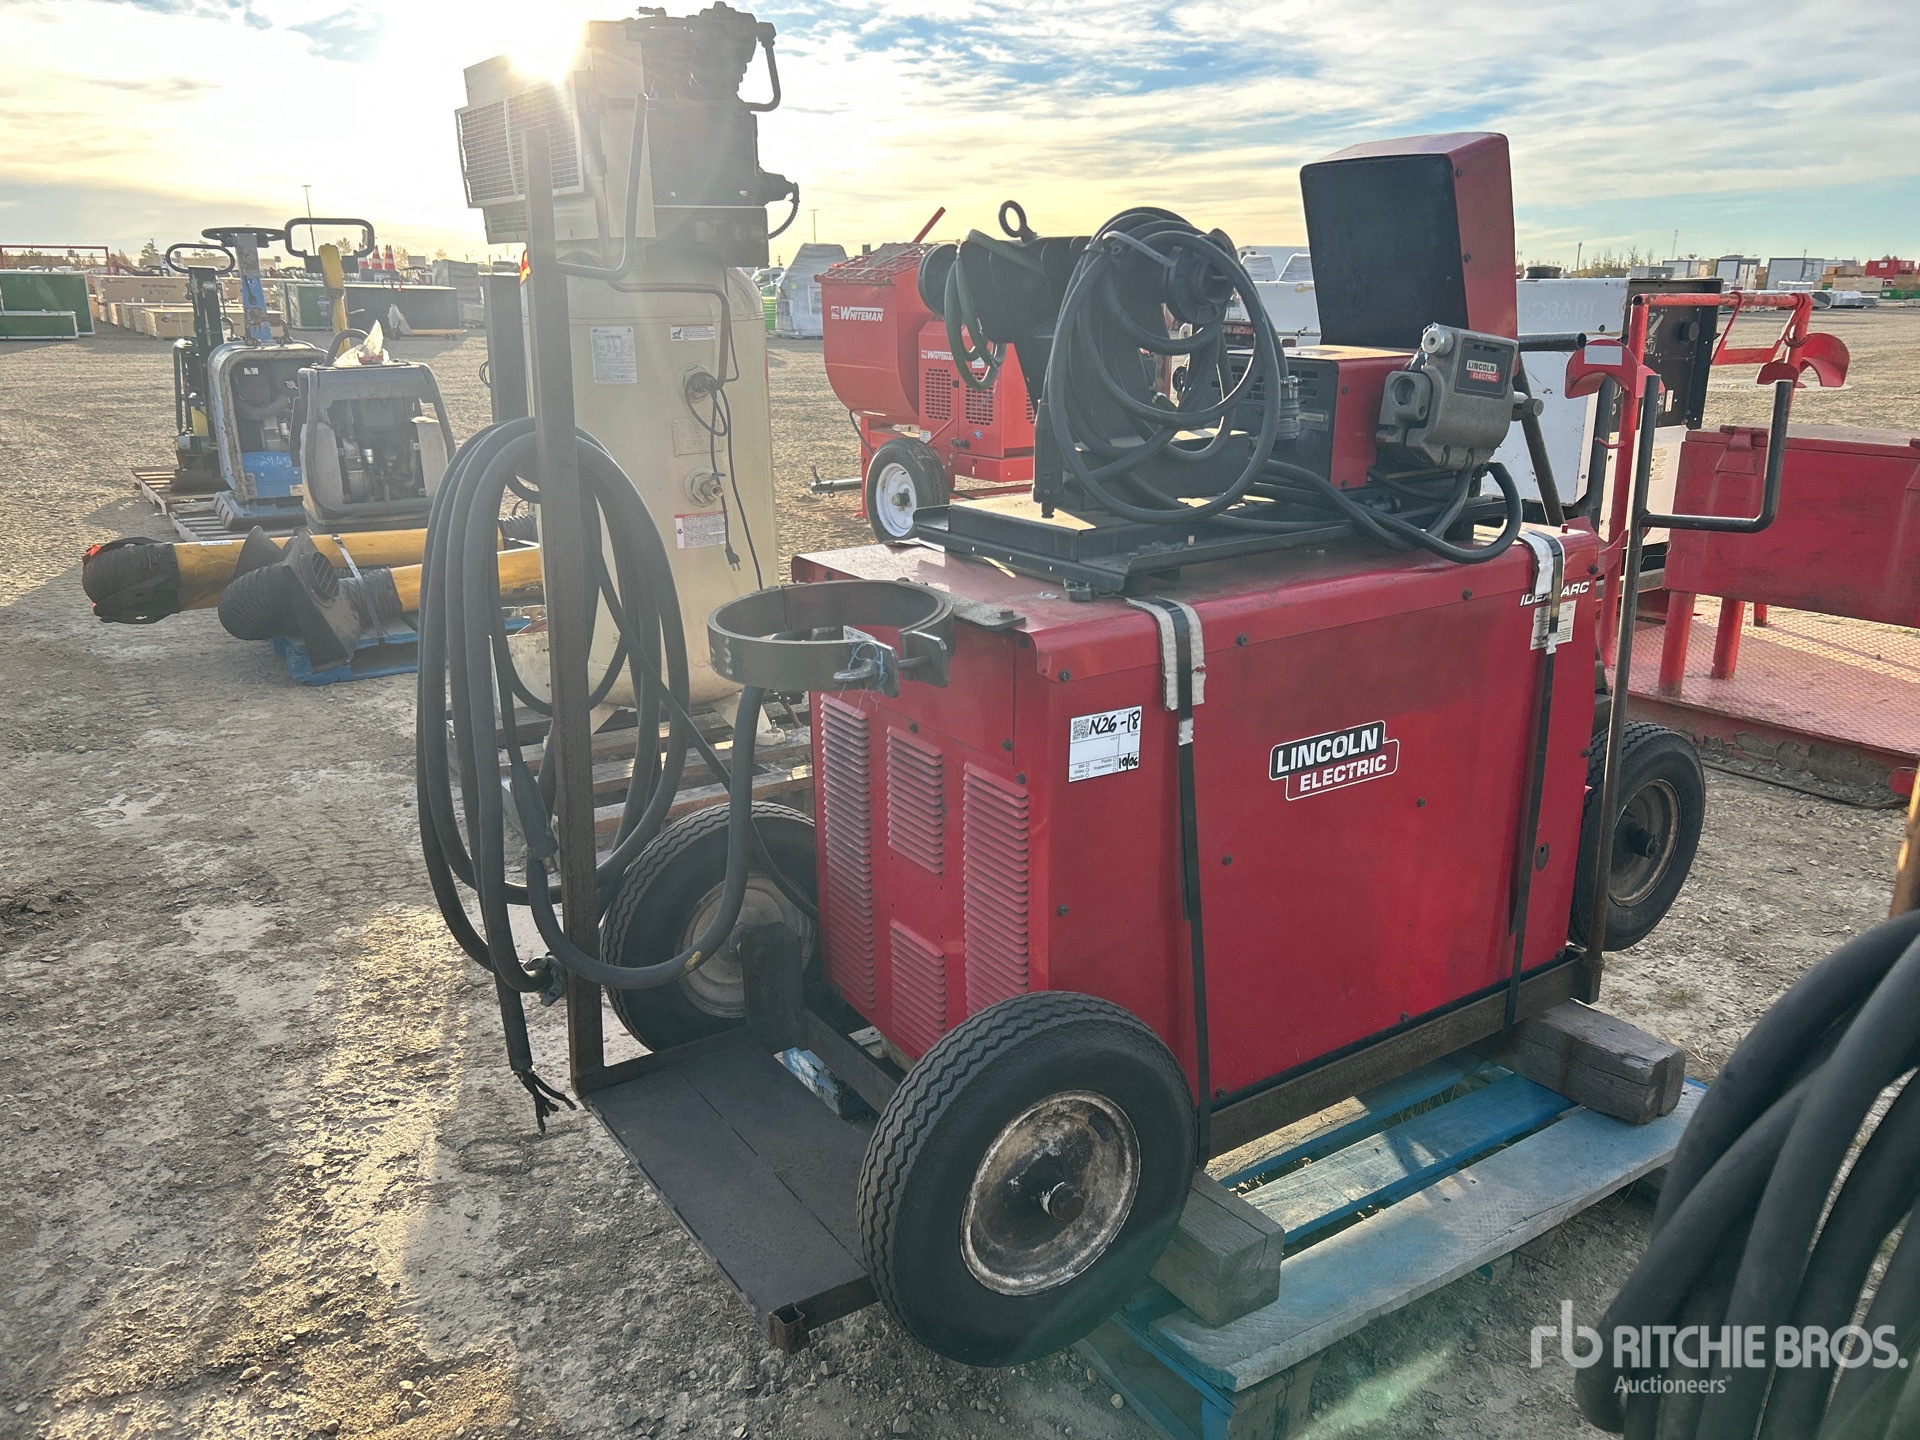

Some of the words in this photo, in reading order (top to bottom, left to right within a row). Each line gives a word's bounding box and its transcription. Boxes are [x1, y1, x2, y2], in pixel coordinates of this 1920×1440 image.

[840, 306, 884, 322] WHITEMAN
[1467, 361, 1496, 373] LINCOLN
[1472, 371, 1498, 382] ELECTRIC
[1276, 727, 1379, 774] LINCOLN
[1299, 754, 1388, 792] ELECTRIC
